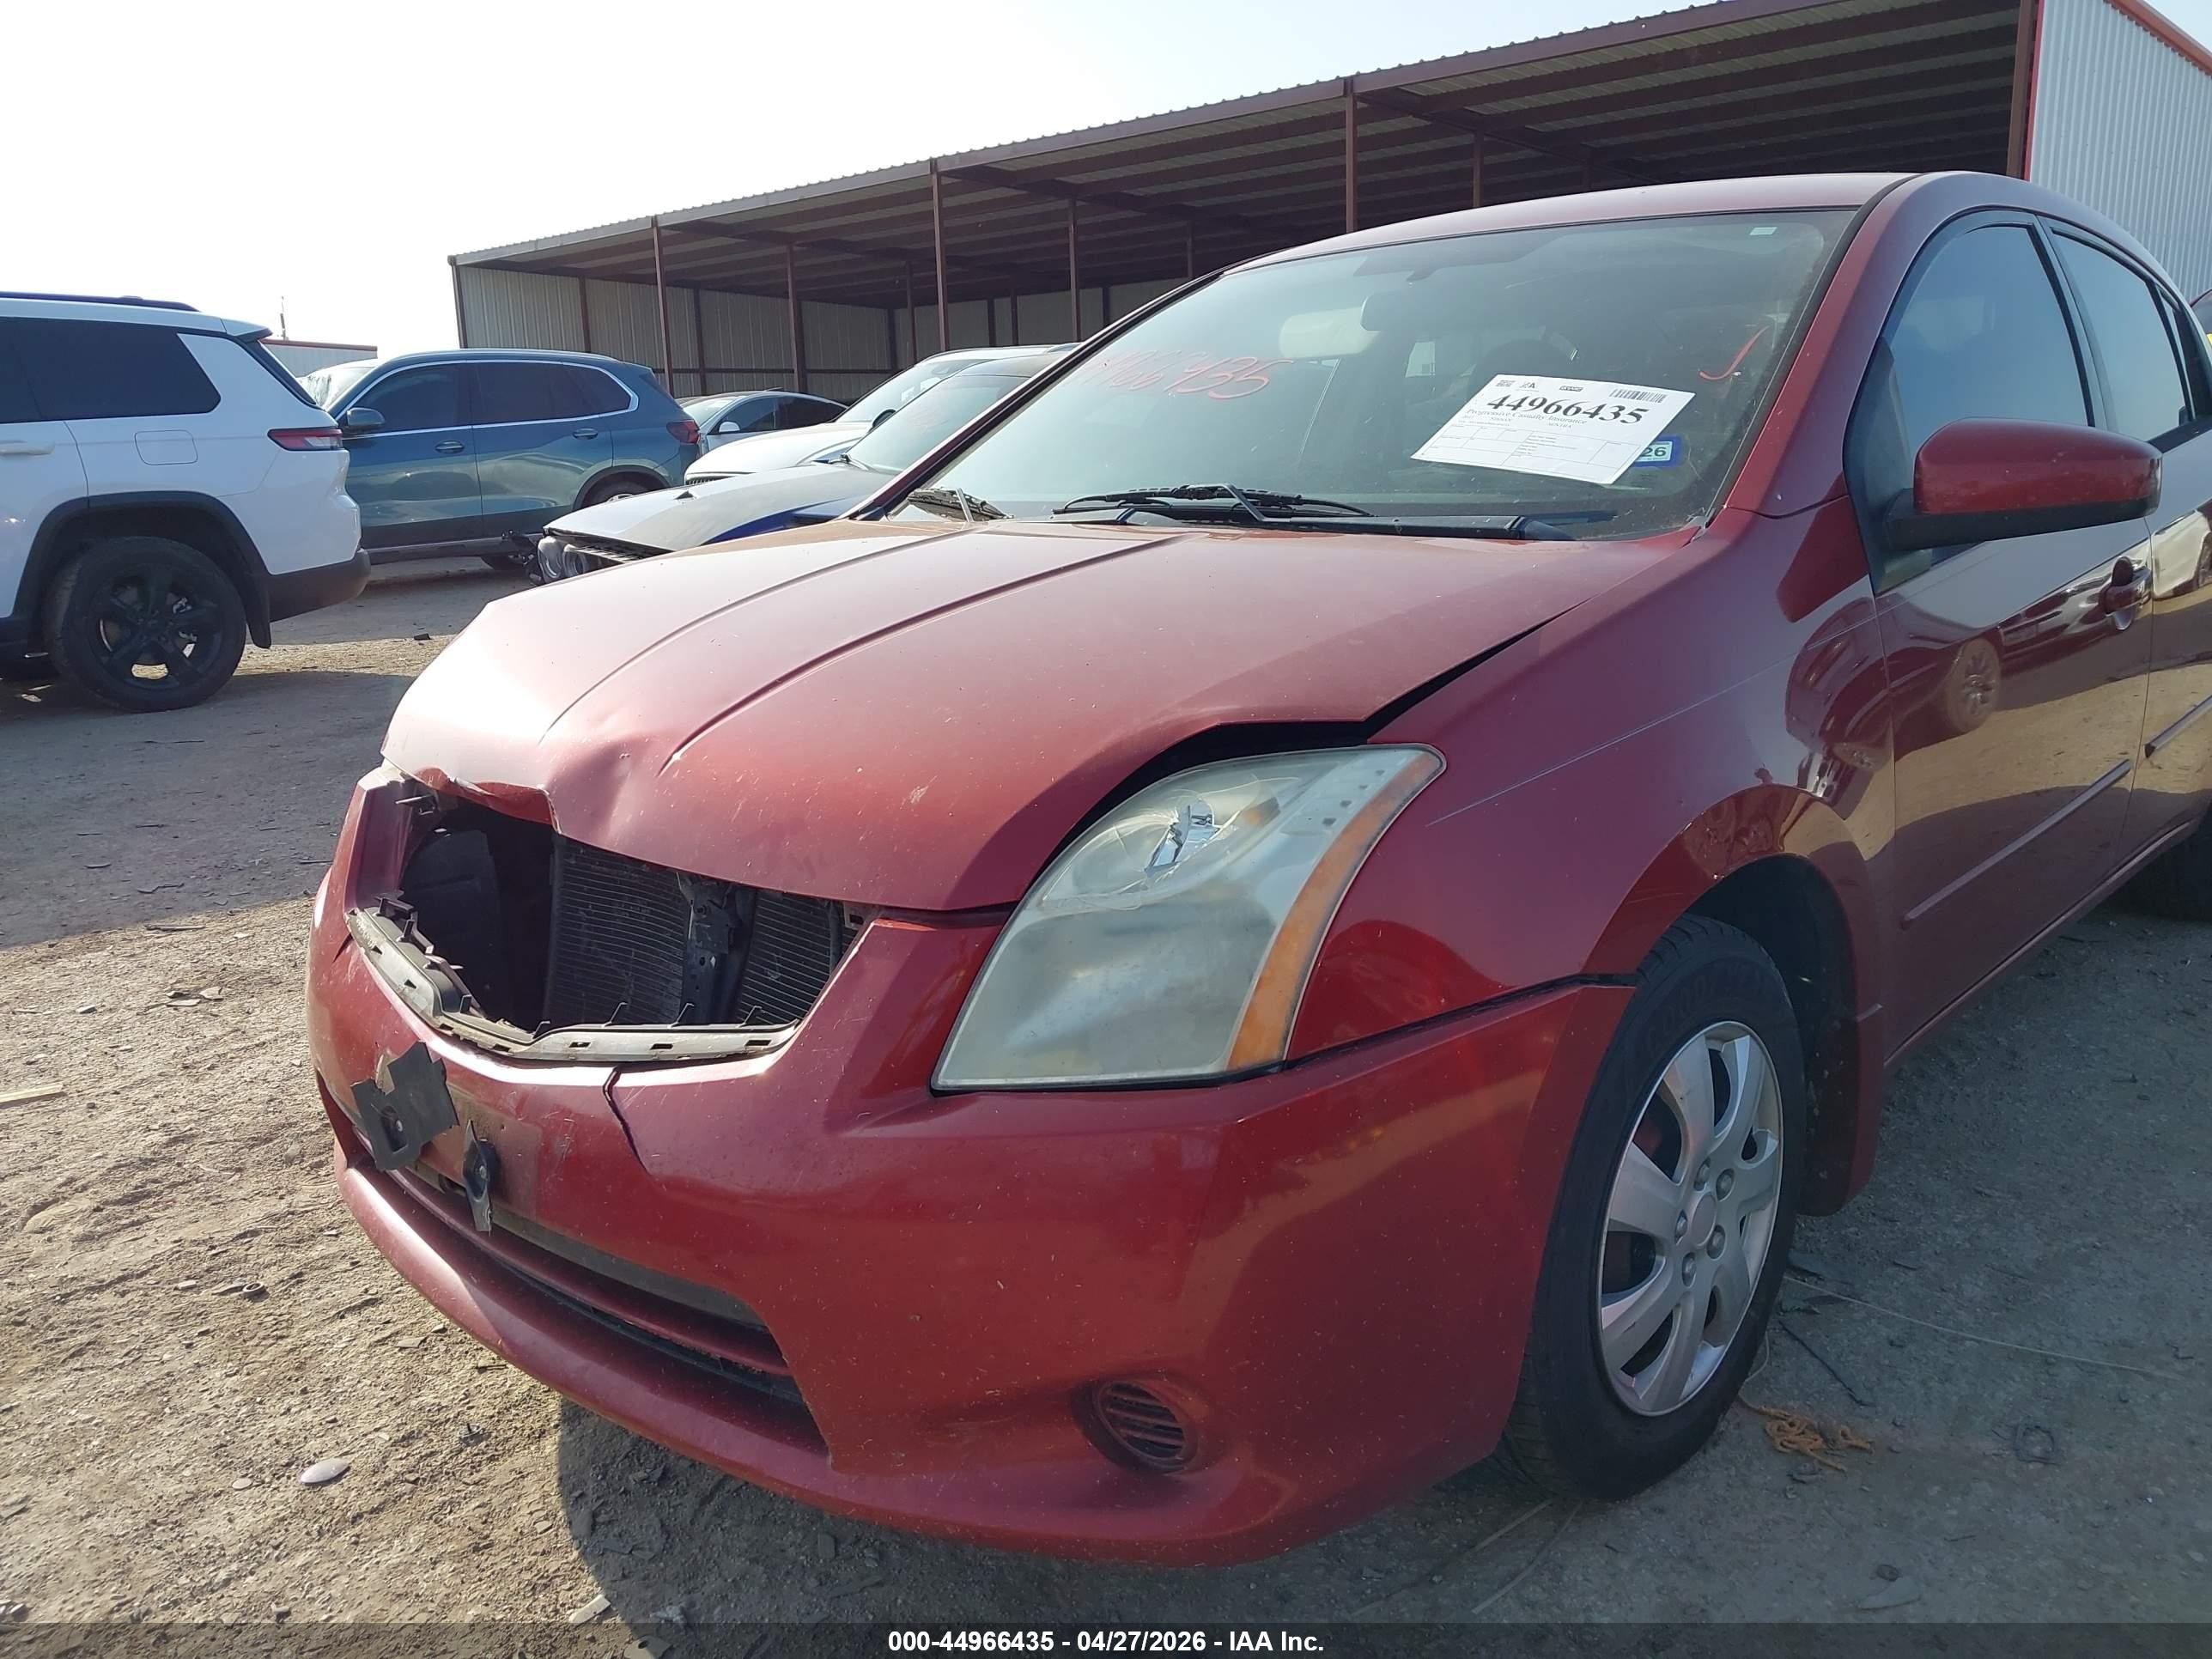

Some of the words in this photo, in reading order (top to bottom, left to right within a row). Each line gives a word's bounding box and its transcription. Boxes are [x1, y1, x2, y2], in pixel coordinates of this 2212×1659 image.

[1487, 393, 1650, 425] 44966435
[1548, 416, 1588, 424] Insurance
[1640, 447, 1667, 457] 26
